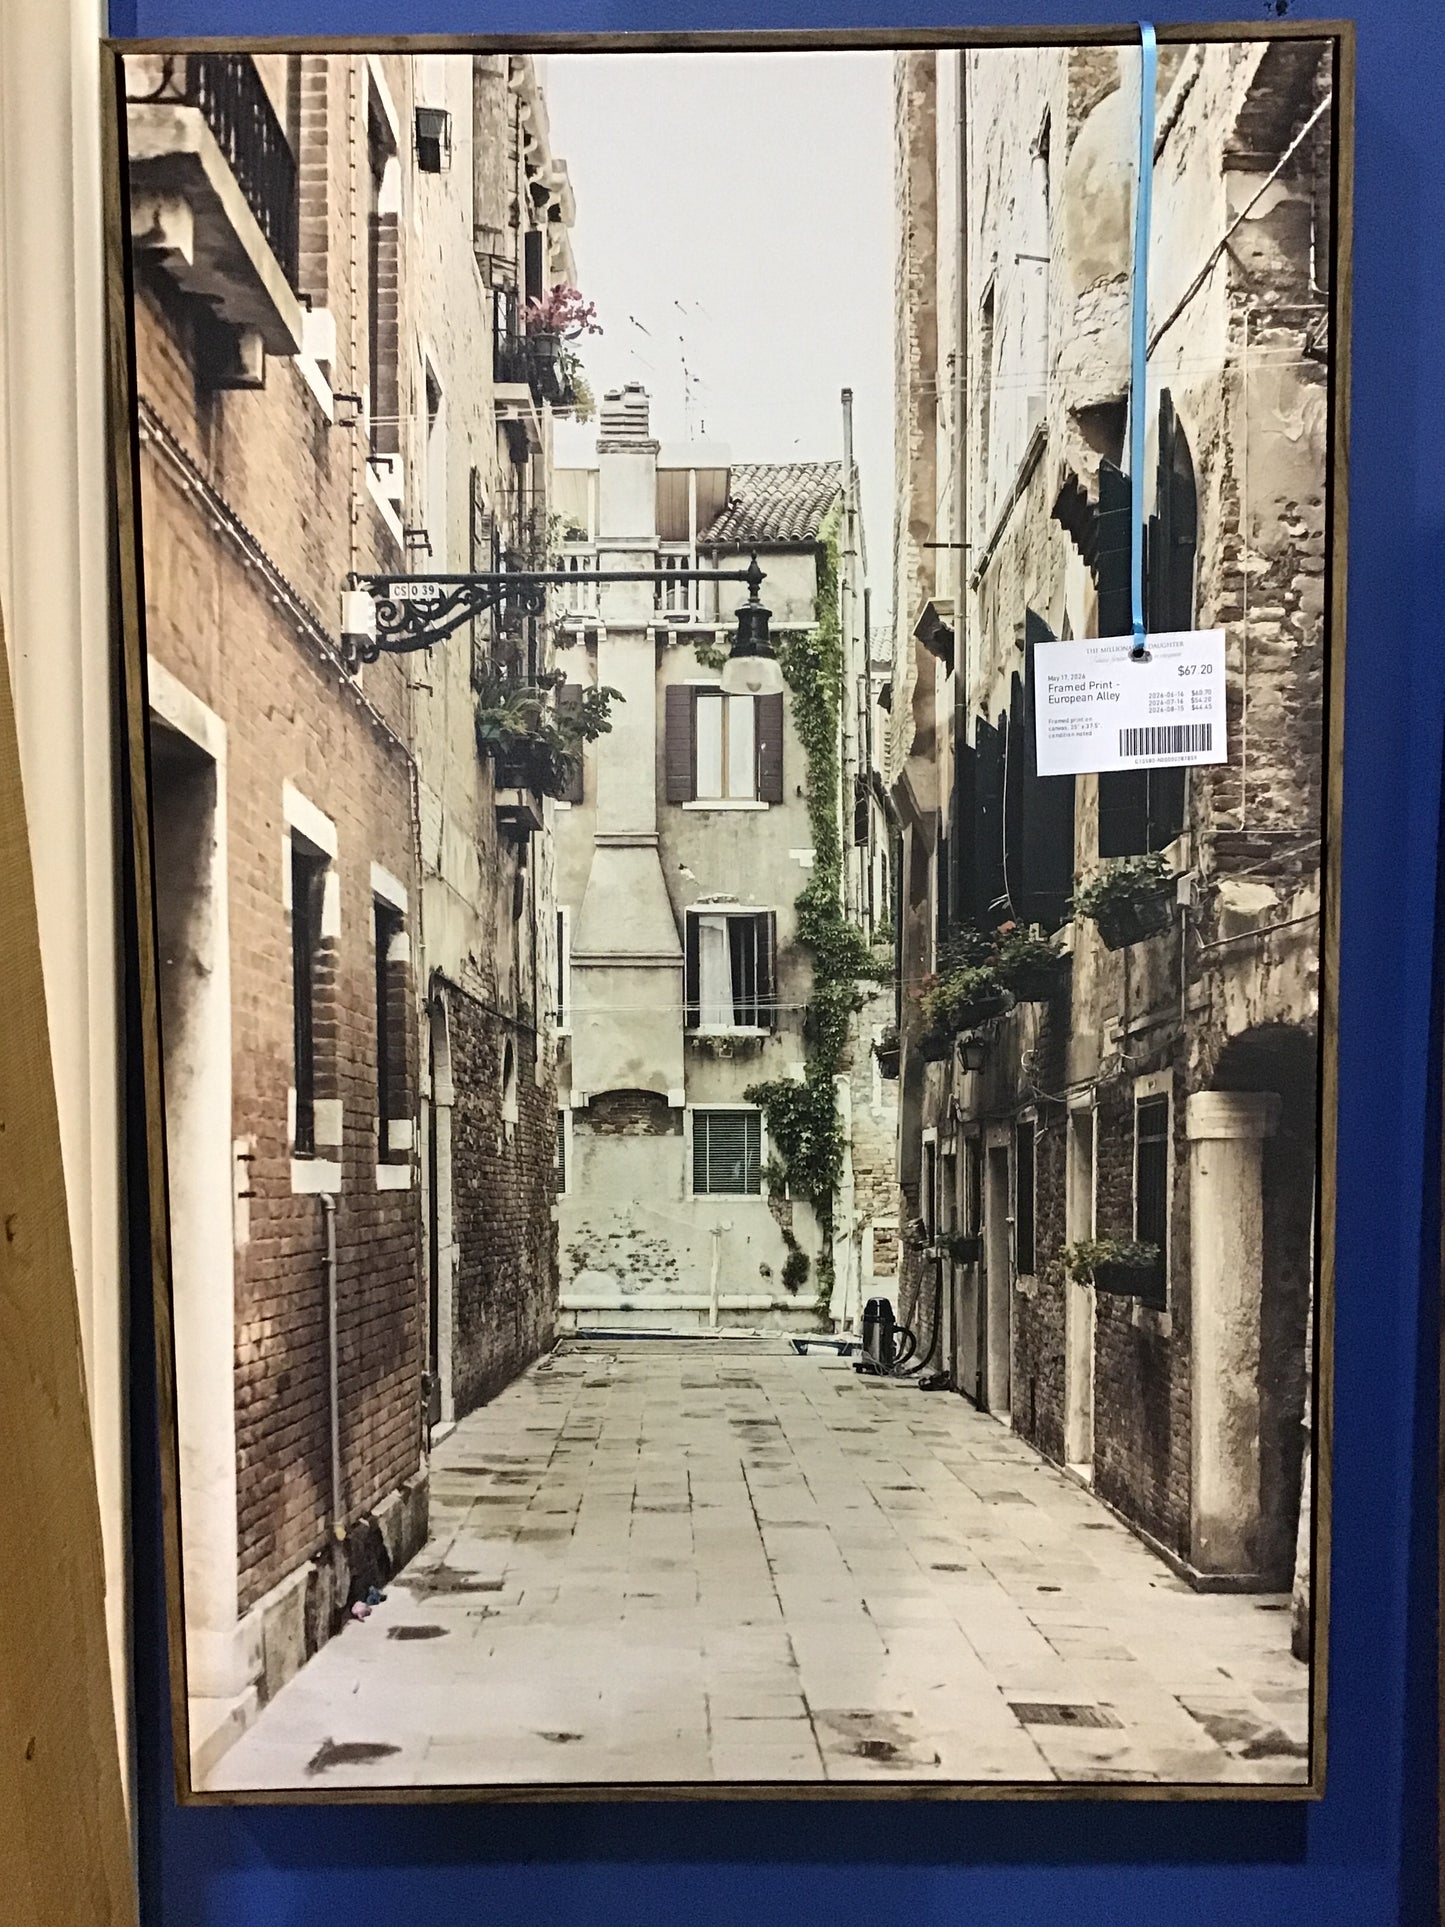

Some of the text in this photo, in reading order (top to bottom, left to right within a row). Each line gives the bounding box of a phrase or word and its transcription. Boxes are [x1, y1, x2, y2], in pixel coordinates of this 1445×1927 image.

[394, 586, 406, 596] CS
[1148, 641, 1184, 649] DAUGHTER
[1177, 664, 1213, 677] $67.20
[1071, 673, 1086, 681] 2026
[1048, 682, 1086, 693] Framed
[1089, 681, 1112, 690] Print
[1048, 691, 1120, 704] European Alley
